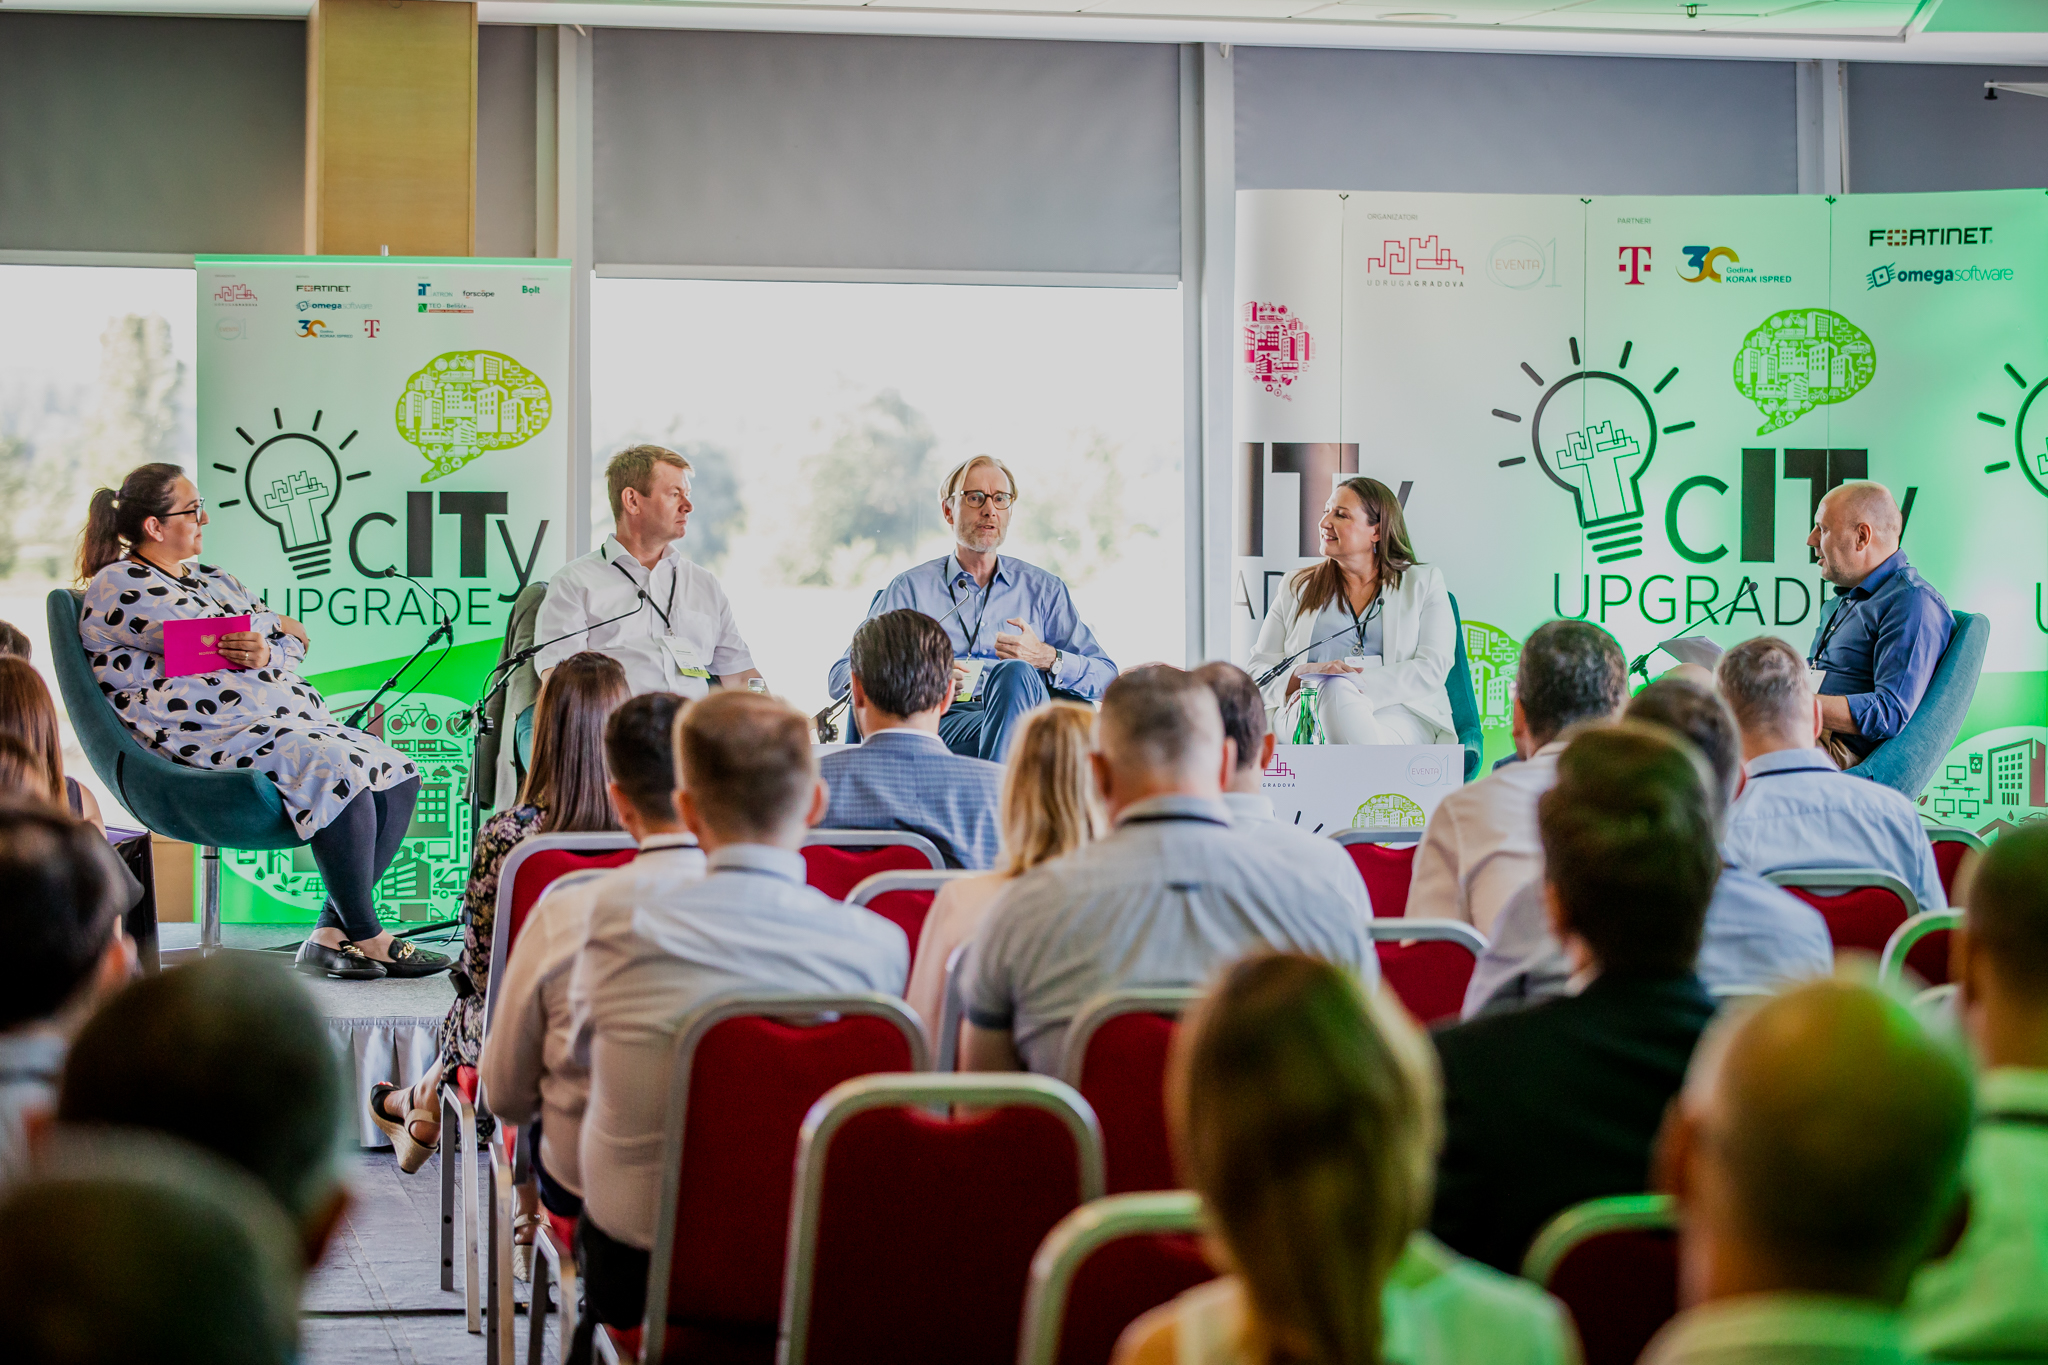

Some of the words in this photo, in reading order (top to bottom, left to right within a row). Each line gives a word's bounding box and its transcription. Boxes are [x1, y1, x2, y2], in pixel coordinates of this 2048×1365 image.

[1367, 213, 1418, 221] ORGANIZATORI
[1617, 217, 1652, 225] PARTNERI
[1869, 226, 1994, 247] FORTINET
[1495, 259, 1540, 271] EVENTA
[1726, 266, 1754, 274] Godina
[1897, 264, 2014, 285] omegasoftware
[1726, 275, 1757, 283] KORAK
[1759, 275, 1792, 283] ISPRED
[296, 285, 351, 293] FORTINET
[522, 285, 540, 296] Bolt
[1411, 767, 1440, 776] EVENTA
